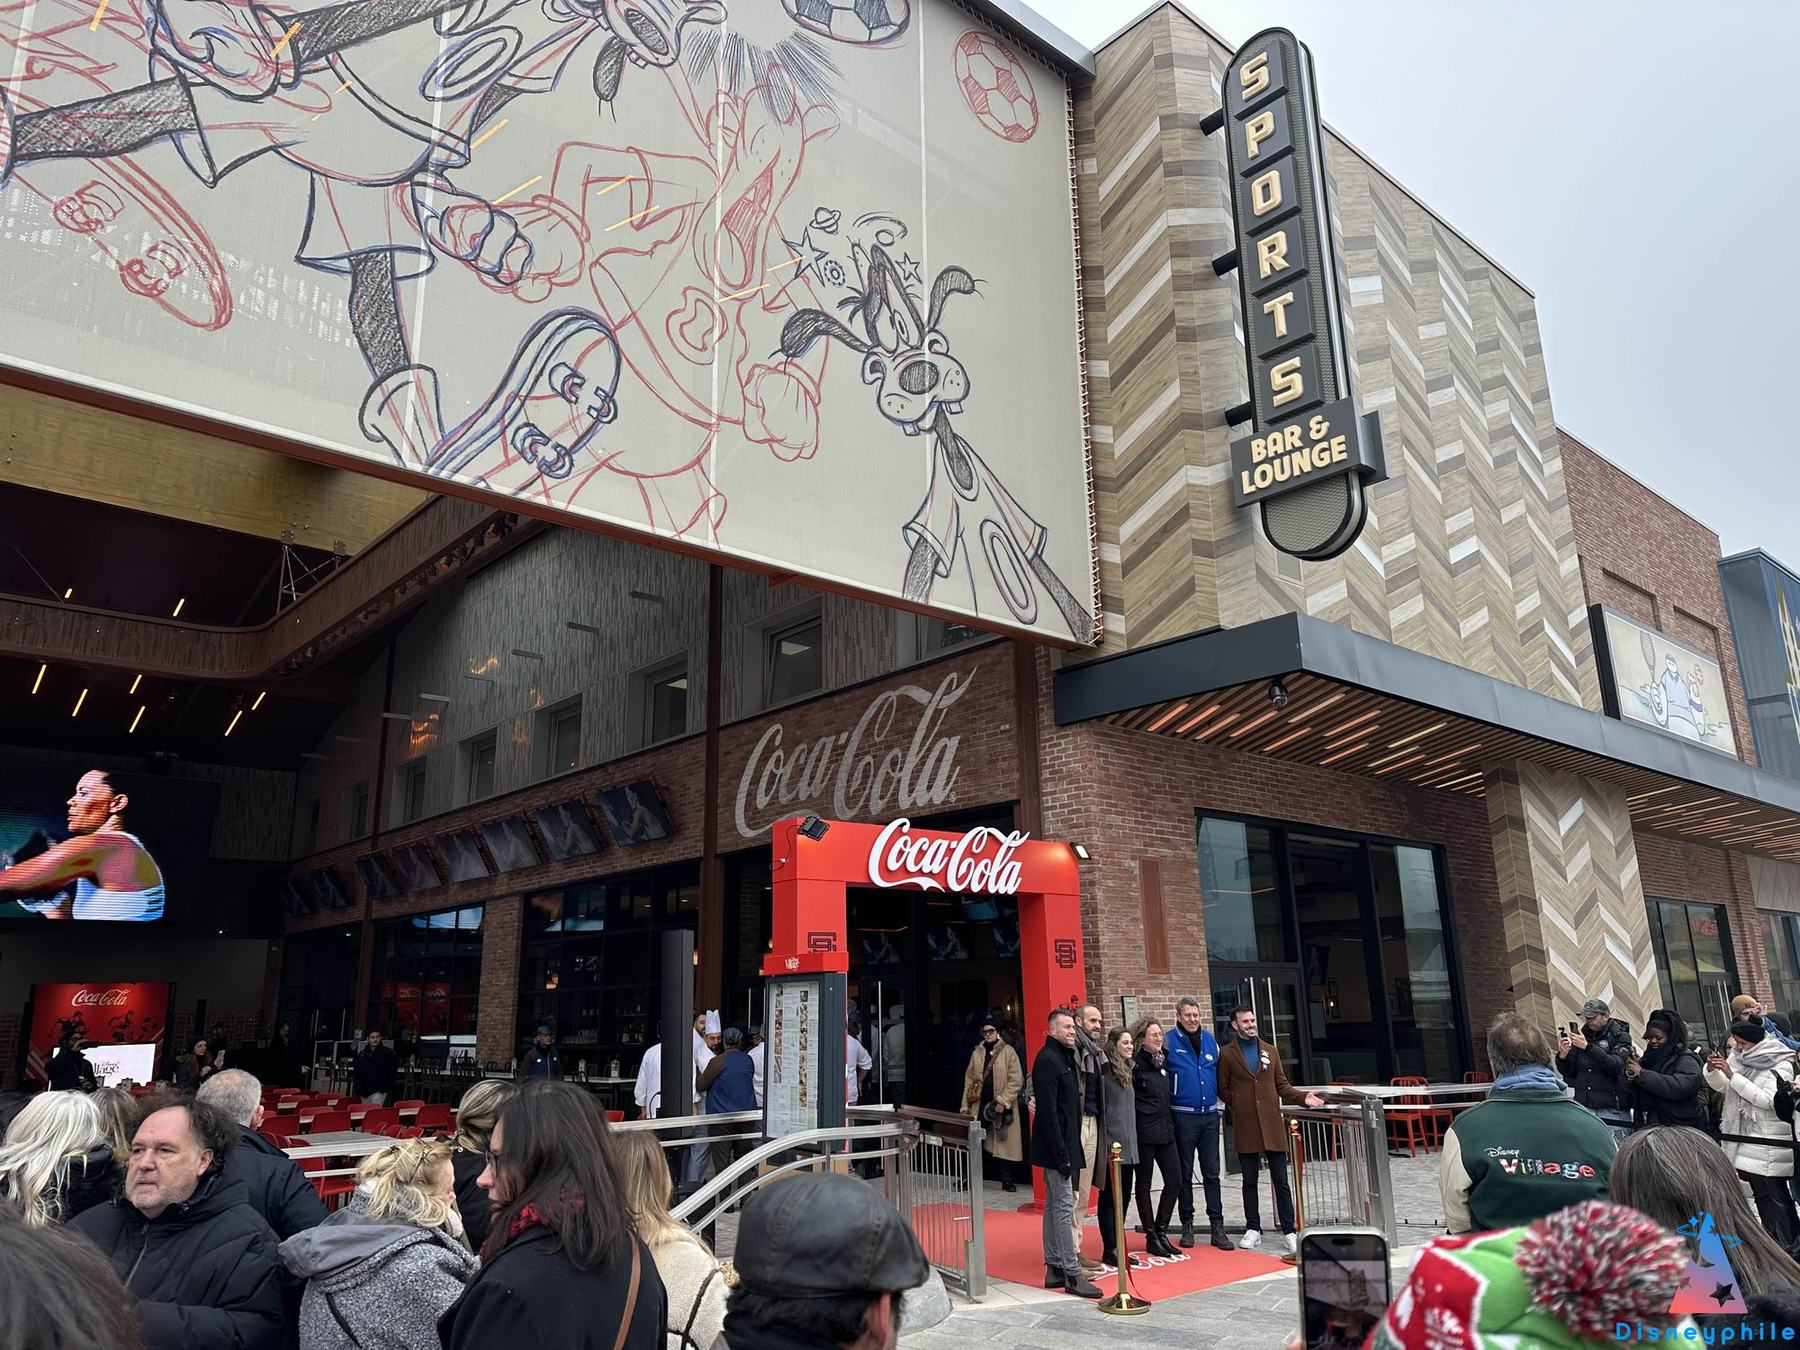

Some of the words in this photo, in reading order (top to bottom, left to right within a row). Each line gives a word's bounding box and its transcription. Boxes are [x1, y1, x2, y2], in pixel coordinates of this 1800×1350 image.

[1239, 52, 1304, 407] SPORTS
[1241, 434, 1348, 495] LOUNGE
[1251, 424, 1303, 464] BAR
[1309, 415, 1330, 440] &
[735, 665, 977, 838] Coca-Cola
[868, 817, 1031, 895] Coca-Cola
[71, 989, 131, 1006] Coca-Cola
[1484, 1146, 1520, 1158] Disney
[1498, 1159, 1596, 1179] Village
